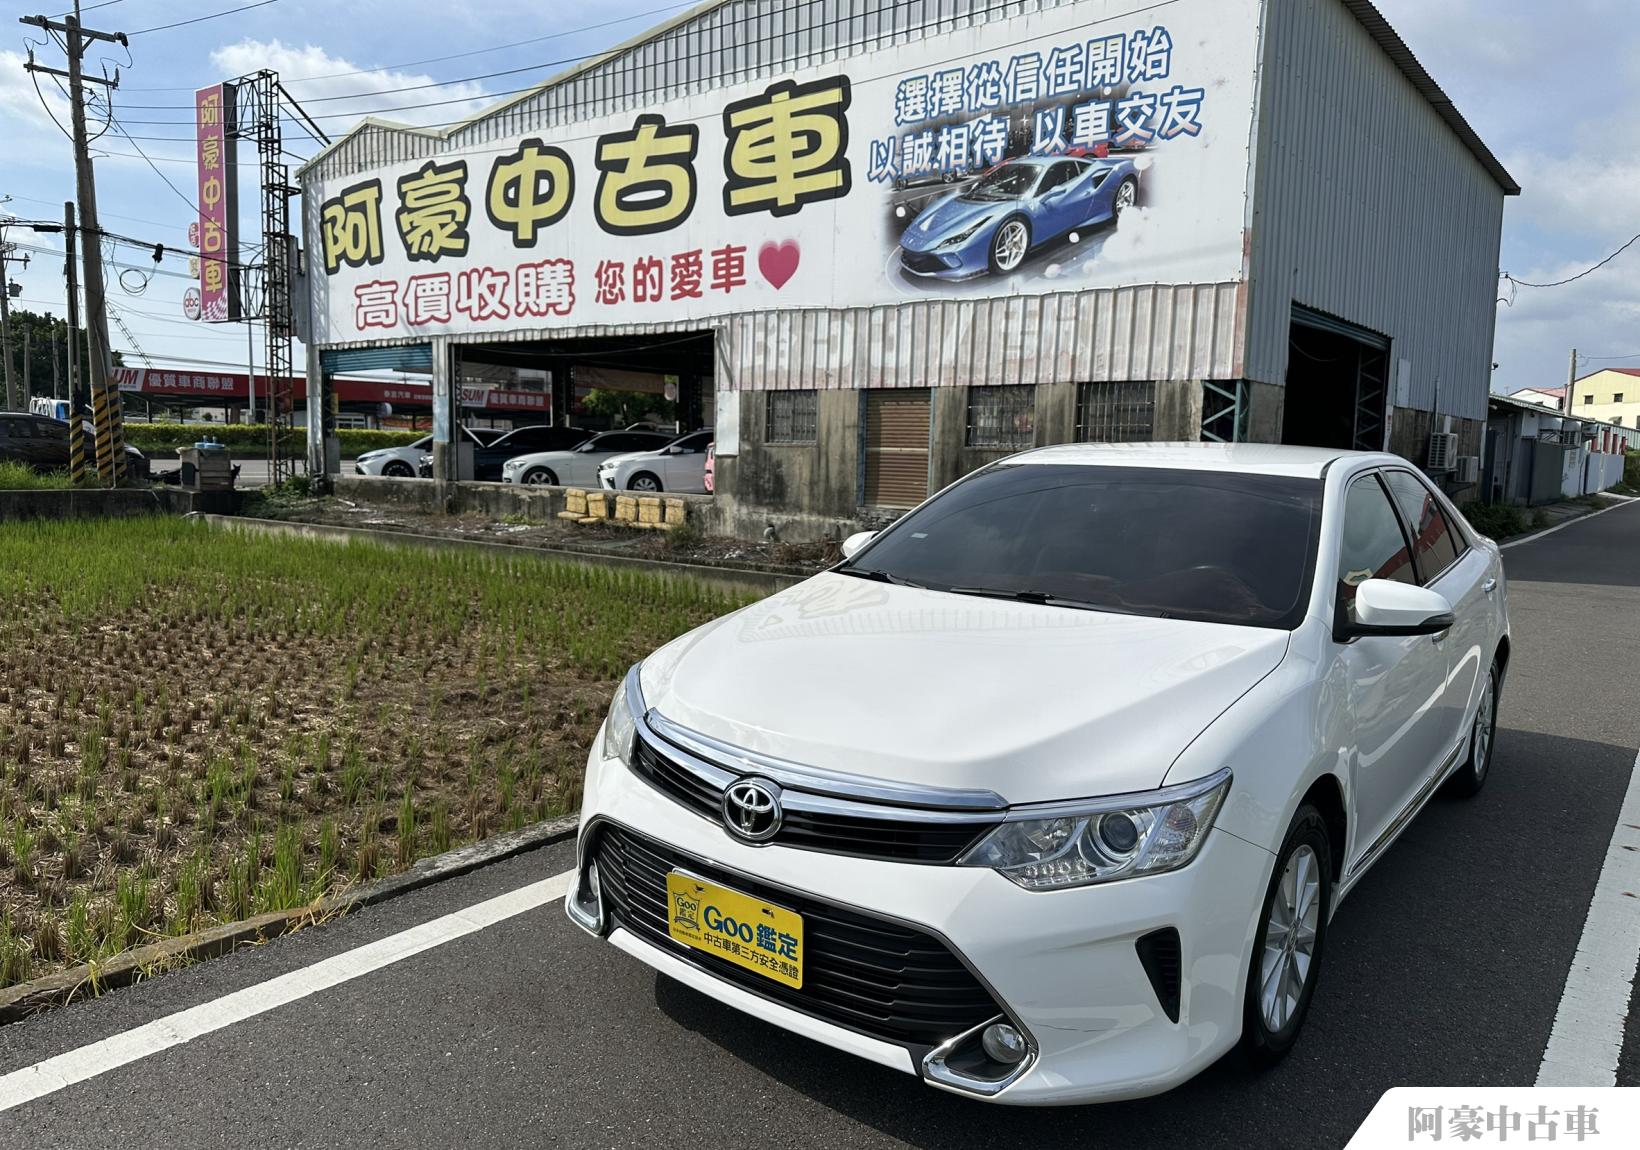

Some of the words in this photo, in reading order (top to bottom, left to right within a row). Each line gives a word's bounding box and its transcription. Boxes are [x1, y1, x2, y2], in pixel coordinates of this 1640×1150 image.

[894, 25, 1174, 126] 選擇從信任開始
[320, 74, 852, 275] 阿豪中古車
[867, 117, 1011, 183] 以誠相待
[1031, 85, 1206, 156] 以車交友
[200, 93, 223, 294] 阿豪中古車
[354, 257, 577, 331] 高價收購
[594, 243, 748, 306] 您的愛車
[703, 931, 799, 981] 中古車第三方安全憑證
